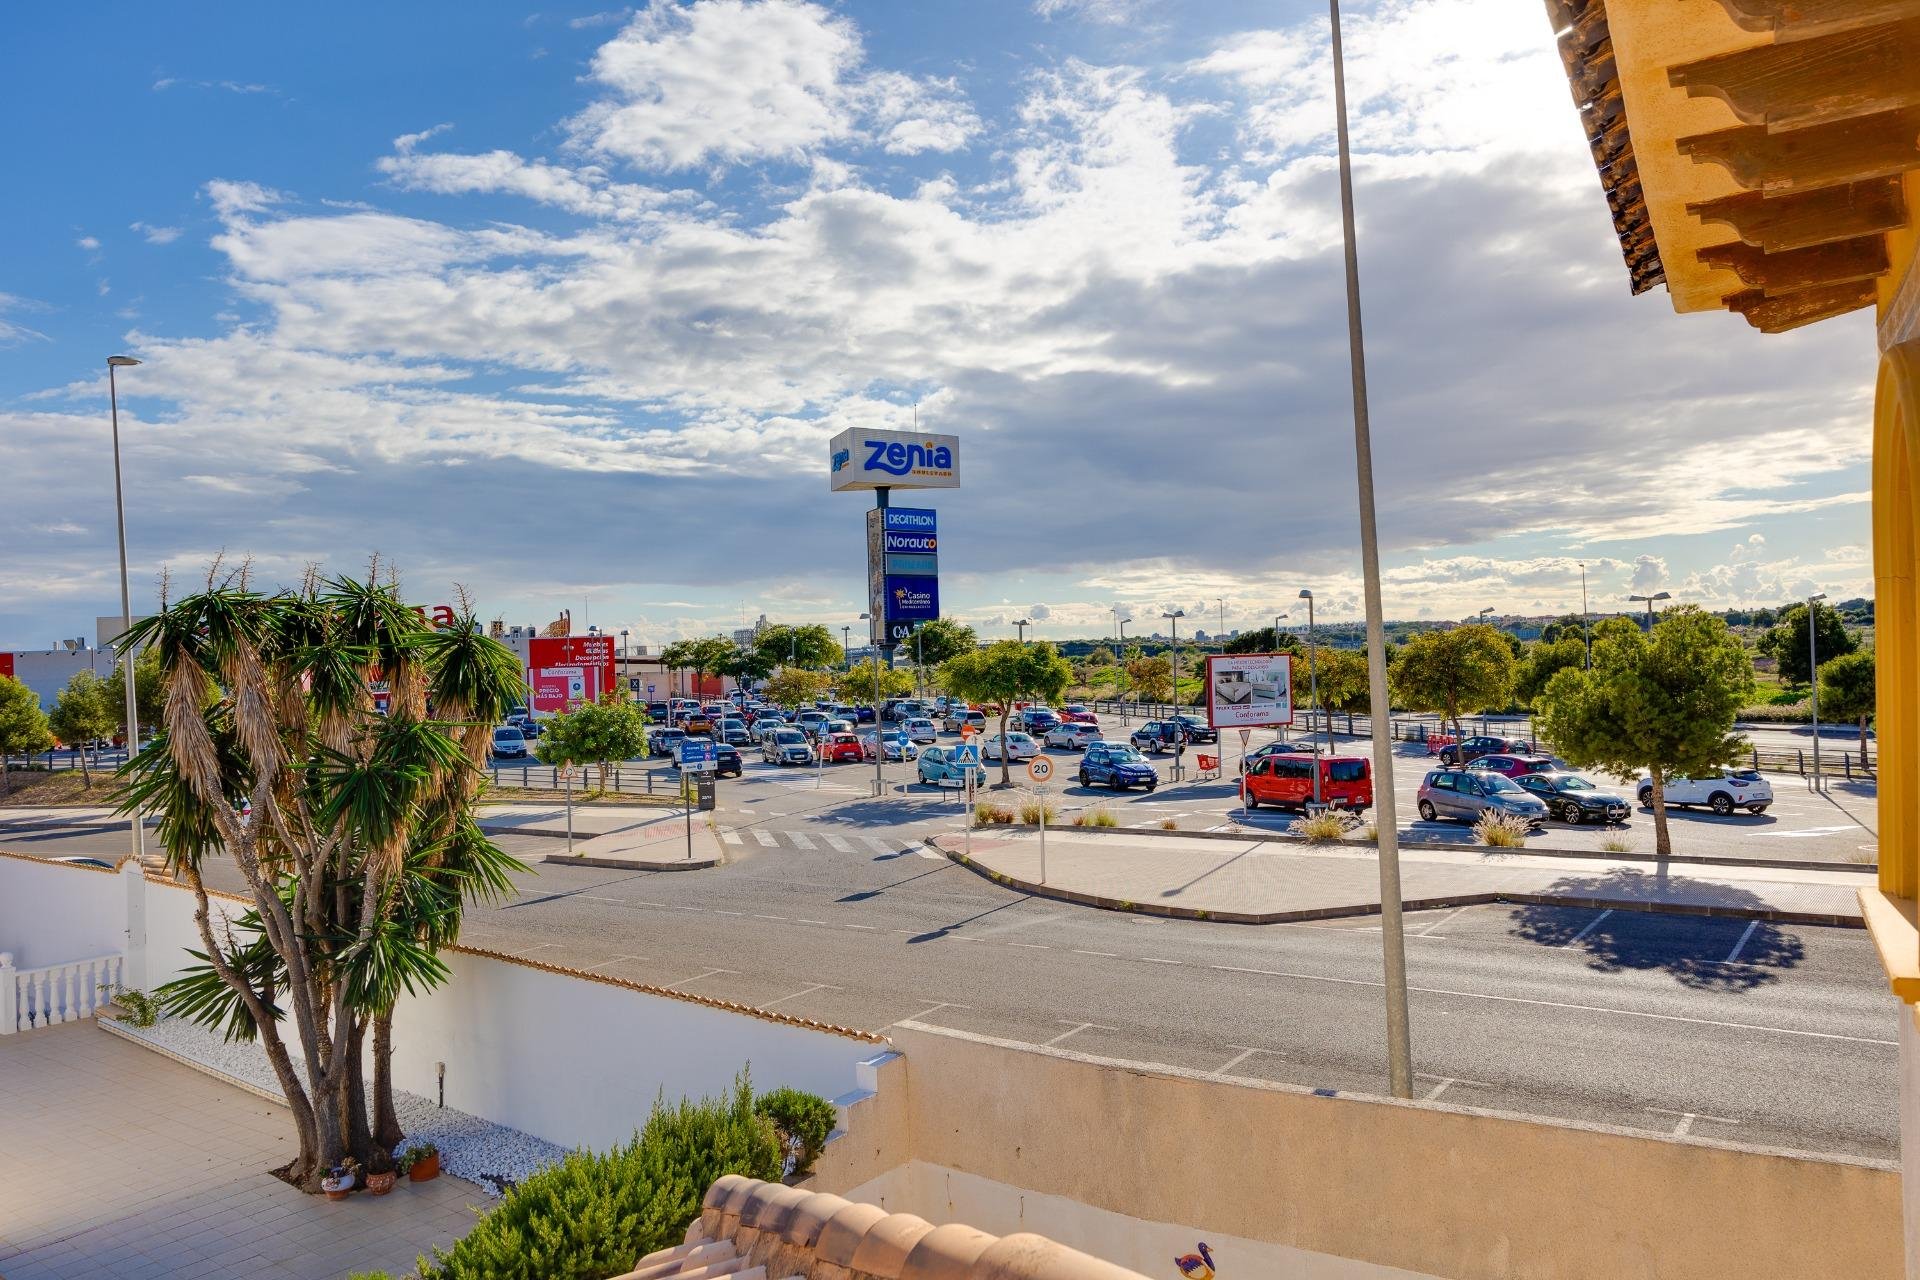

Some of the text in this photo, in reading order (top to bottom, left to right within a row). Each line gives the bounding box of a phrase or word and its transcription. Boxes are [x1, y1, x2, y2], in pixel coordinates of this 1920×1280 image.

[888, 514, 934, 526] DECATHLON
[887, 535, 937, 549] Norauto
[907, 591, 931, 600] Casino
[1034, 764, 1048, 774] 20
